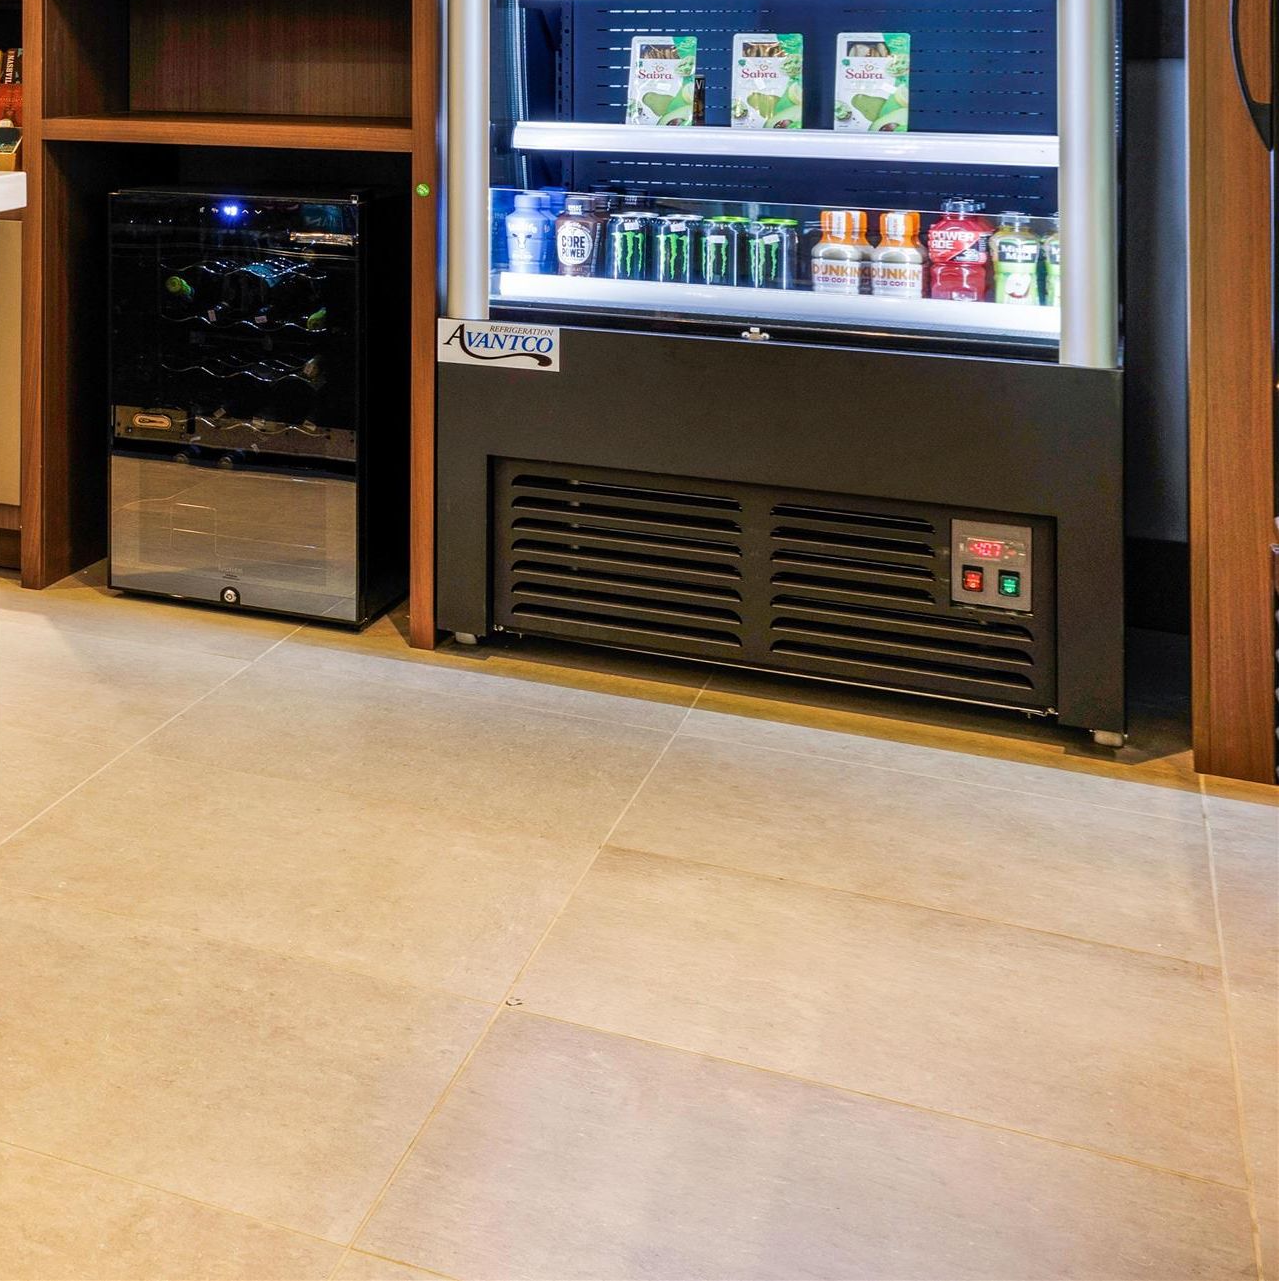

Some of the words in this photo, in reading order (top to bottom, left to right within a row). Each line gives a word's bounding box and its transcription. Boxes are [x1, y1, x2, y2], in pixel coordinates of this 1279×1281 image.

[638, 68, 673, 80] Sabra
[741, 68, 777, 80] Sabra
[845, 68, 883, 80] Sabra
[561, 236, 585, 248] CORE
[932, 231, 974, 241] POWER
[561, 249, 585, 258] POWER
[489, 325, 554, 336] REFRIGERATION
[443, 323, 553, 357] AVANTCO
